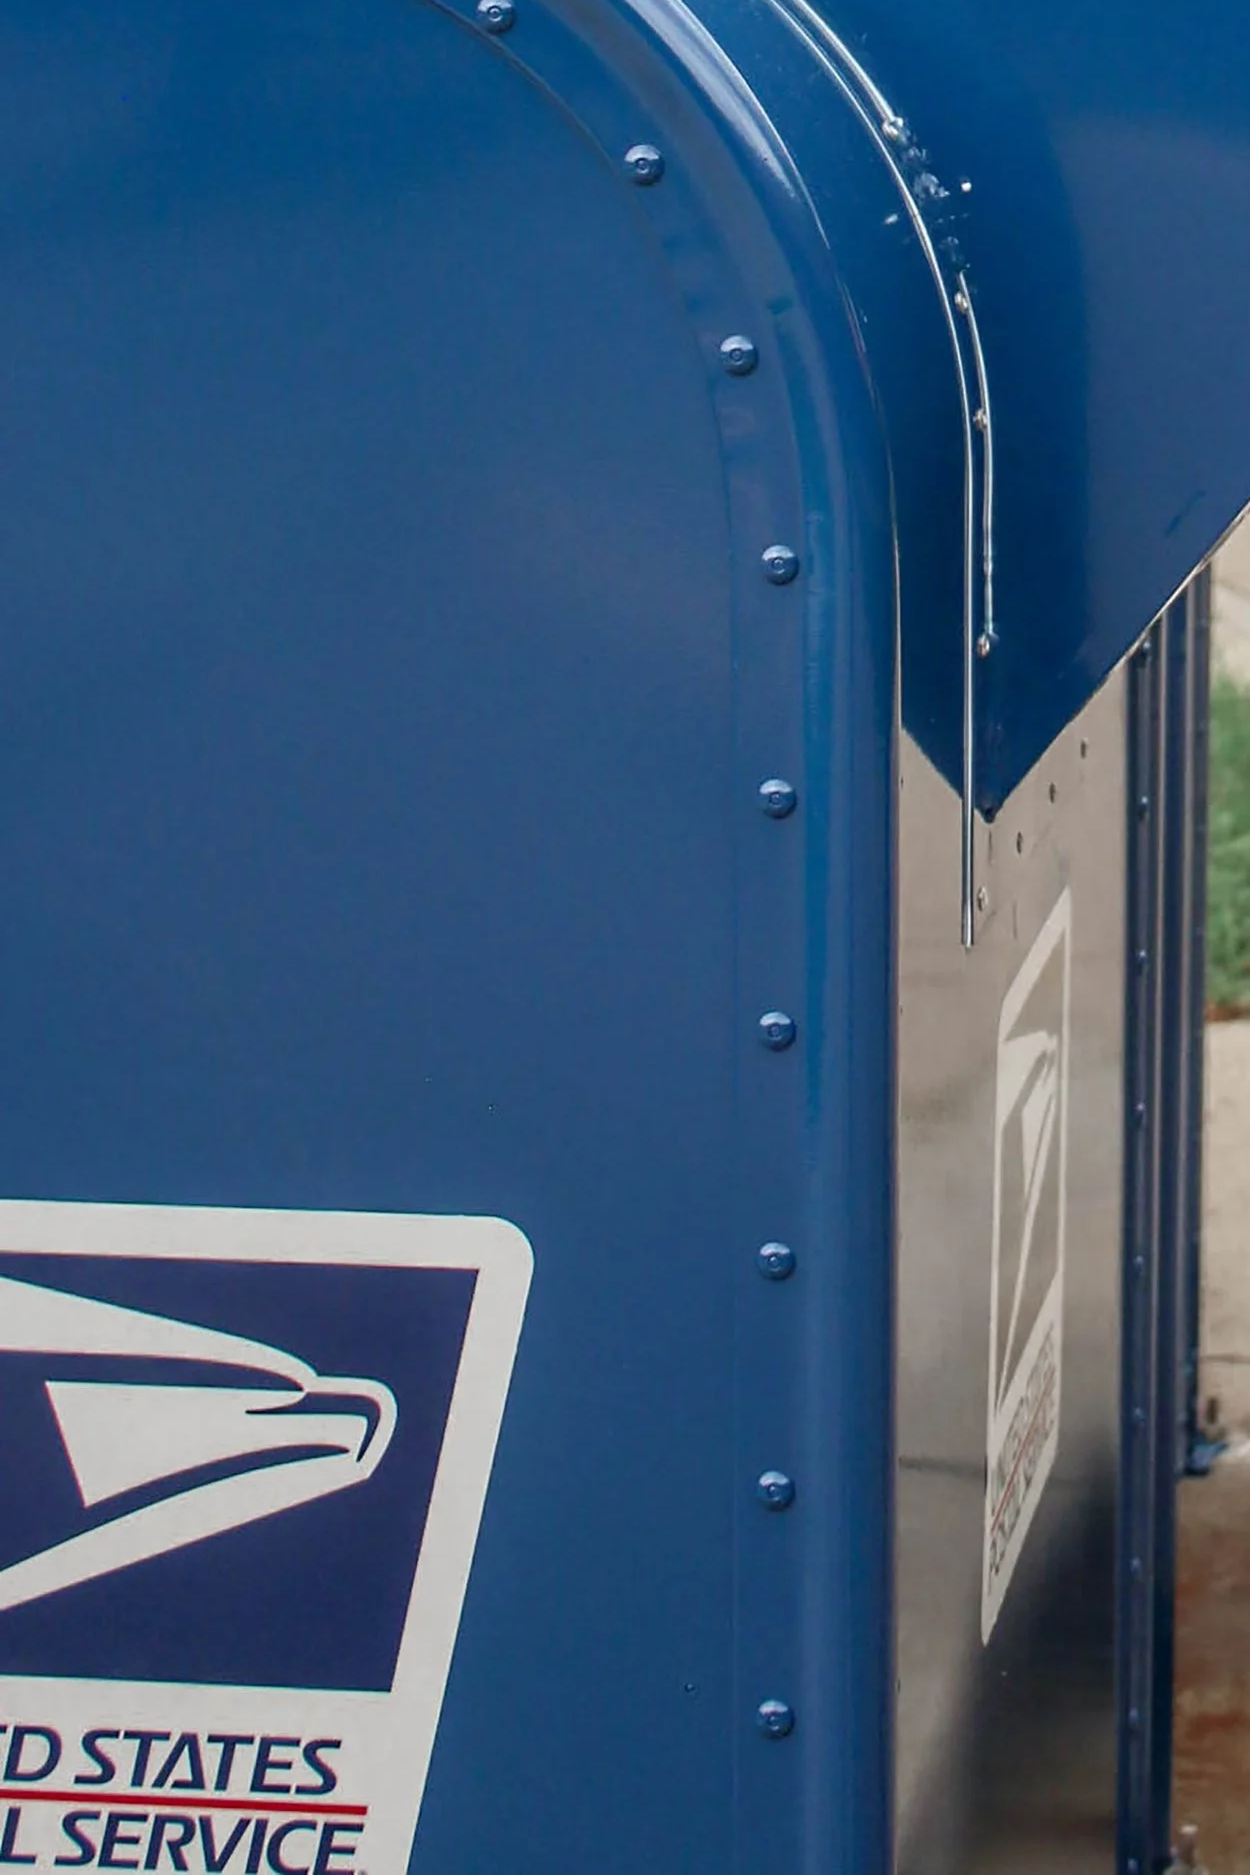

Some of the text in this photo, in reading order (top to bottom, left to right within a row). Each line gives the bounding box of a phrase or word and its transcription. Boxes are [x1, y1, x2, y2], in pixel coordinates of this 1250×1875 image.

[0, 1725, 342, 1795] D STATES
[54, 1811, 364, 1875] SERVICE
